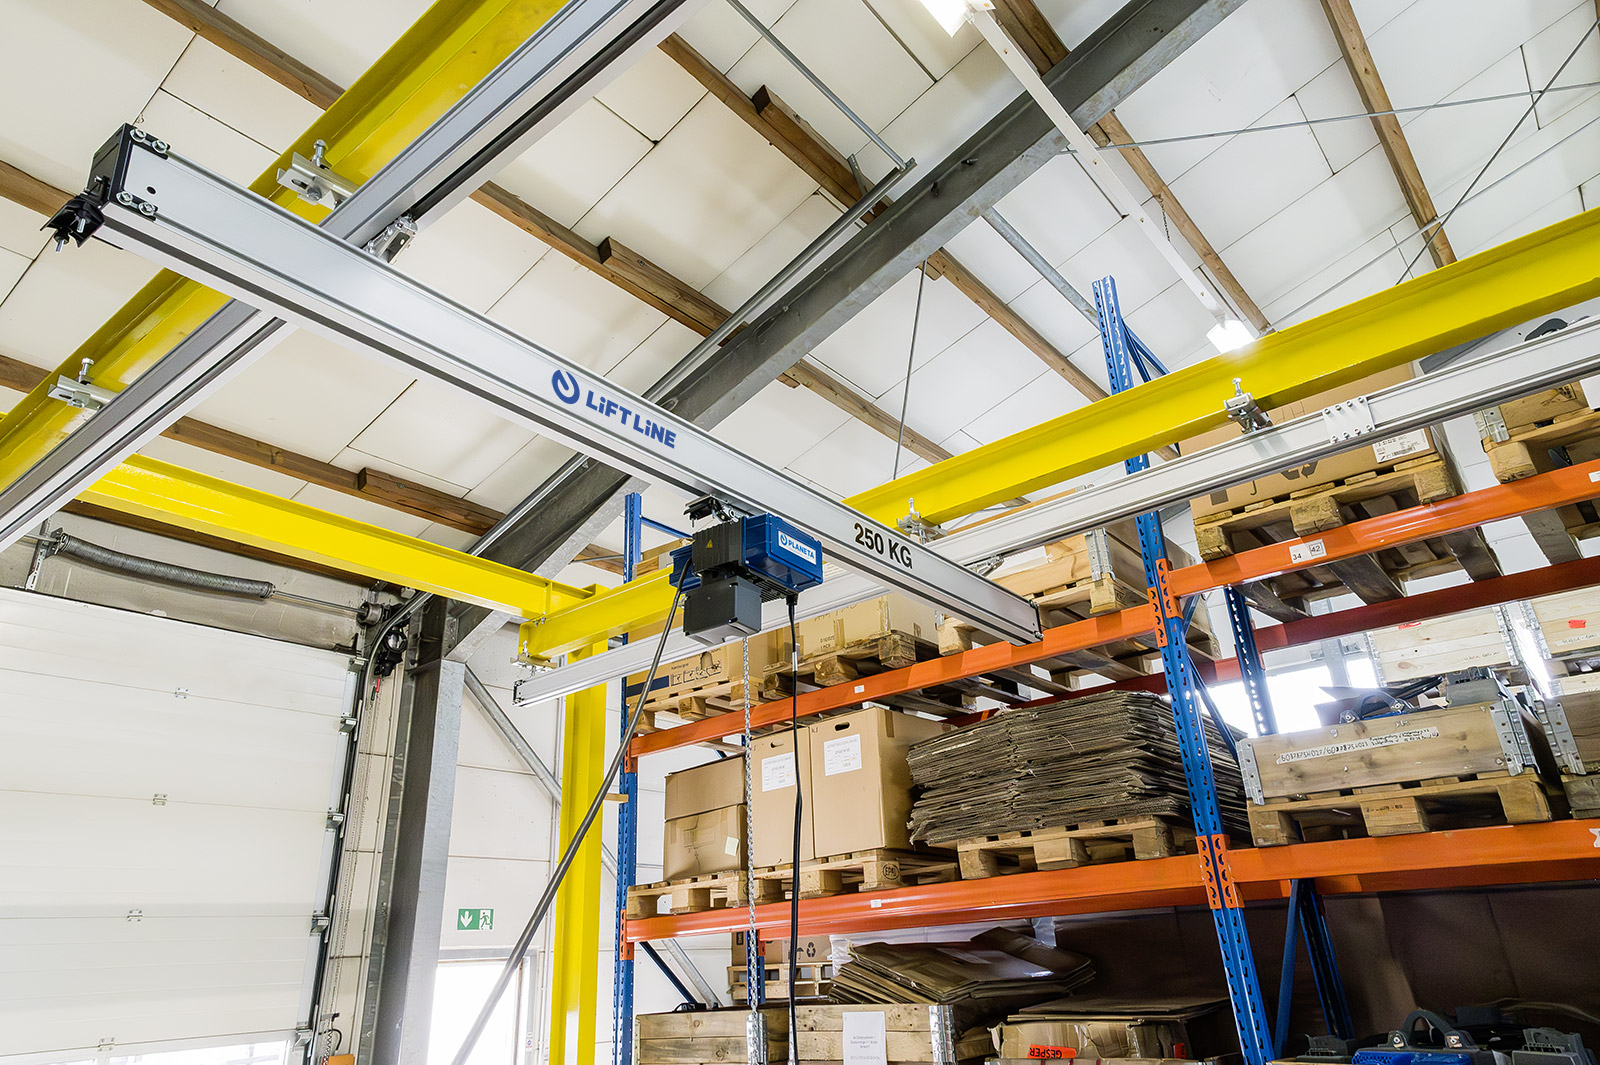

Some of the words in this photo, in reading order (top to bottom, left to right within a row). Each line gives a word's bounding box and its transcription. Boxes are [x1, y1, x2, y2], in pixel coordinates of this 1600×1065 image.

[788, 539, 815, 559] PLANETA
[854, 522, 884, 555] 250
[888, 538, 913, 569] KG
